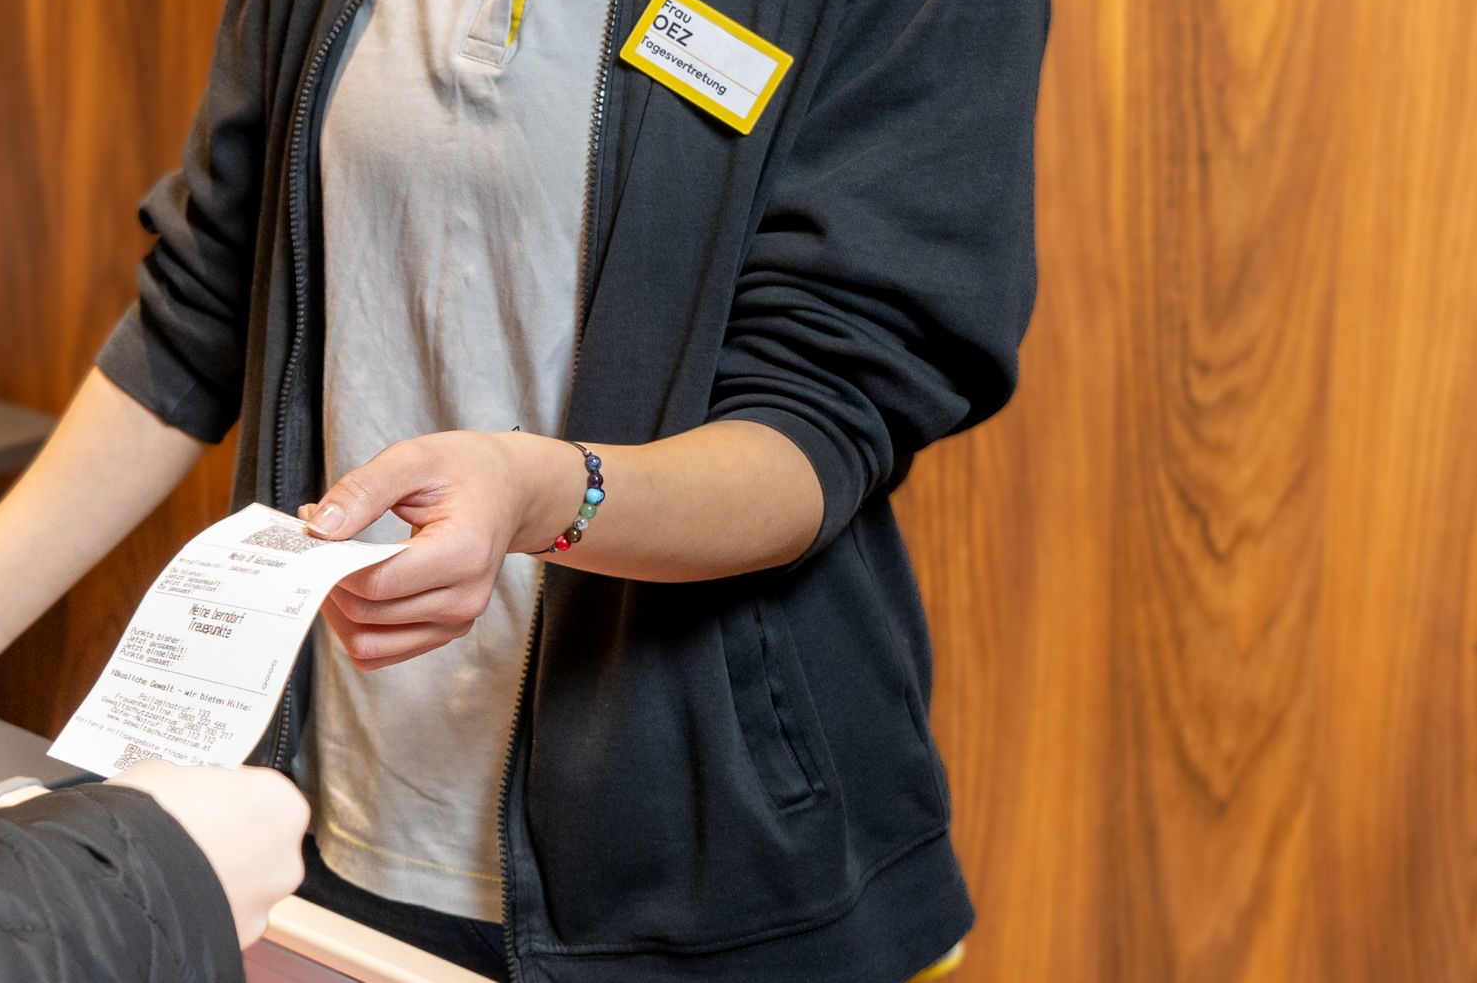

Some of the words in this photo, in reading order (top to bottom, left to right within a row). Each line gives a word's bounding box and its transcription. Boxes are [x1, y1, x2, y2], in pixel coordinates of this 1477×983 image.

[662, 0, 692, 24] Frau
[653, 14, 693, 47] OEZ
[641, 35, 727, 95] Tagesvertretung
[150, 680, 174, 693] Gewalt
[184, 690, 197, 698] wir
[199, 692, 225, 706] bieten
